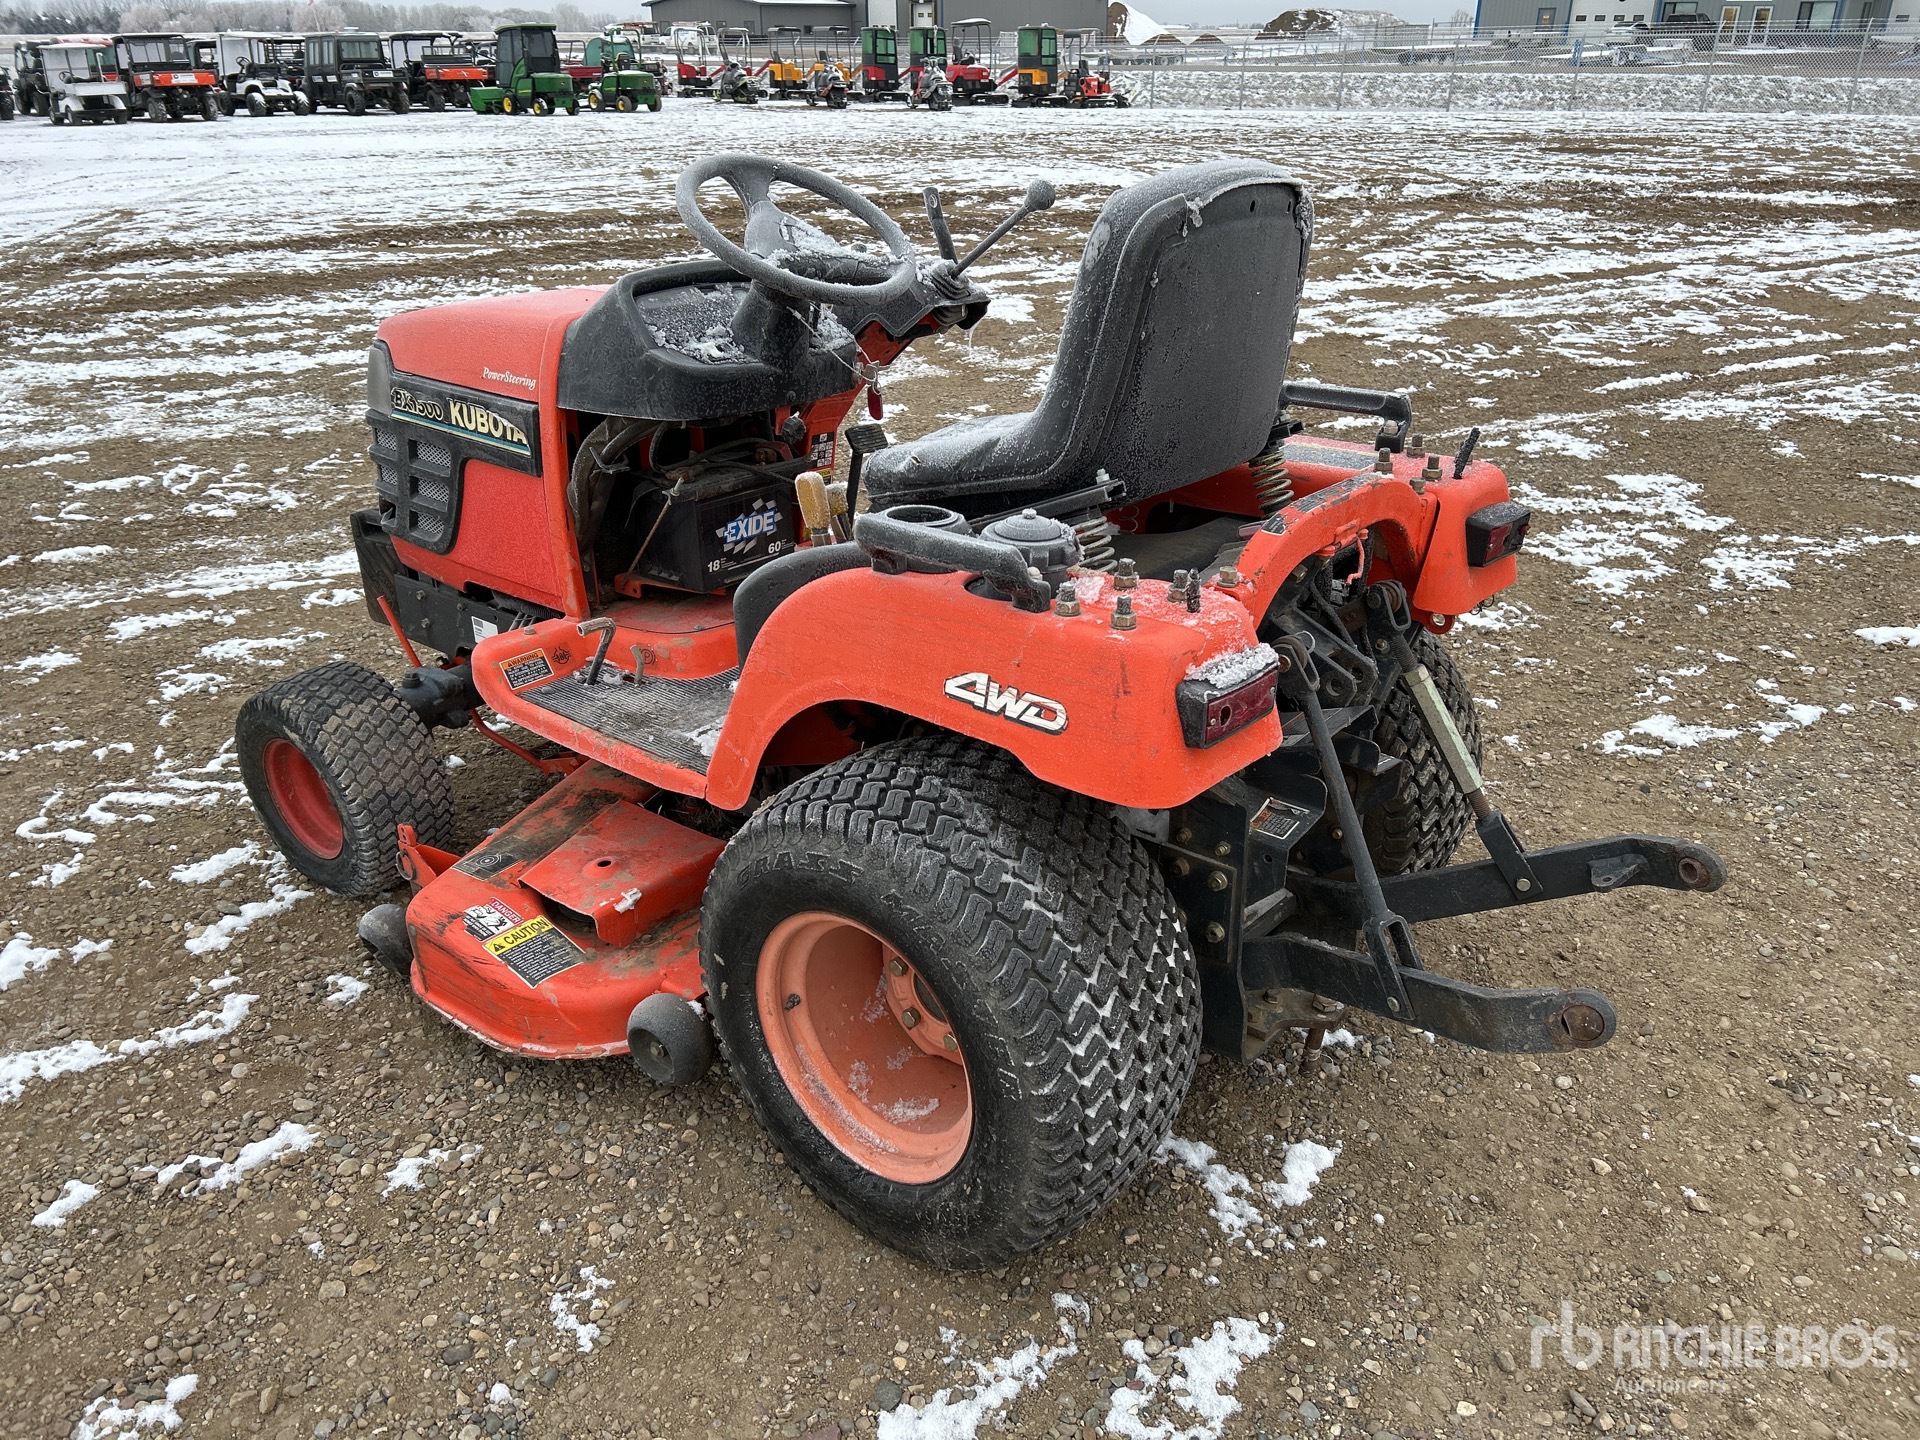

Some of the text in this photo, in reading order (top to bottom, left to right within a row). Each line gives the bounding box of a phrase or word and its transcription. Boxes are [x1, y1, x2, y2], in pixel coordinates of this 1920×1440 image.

[482, 367, 537, 391] PowerSteering
[449, 399, 528, 445] KUBOTA
[724, 511, 776, 544] EXIDE
[768, 540, 782, 554] 60
[707, 560, 720, 573] 18
[511, 653, 539, 666] WARNING
[943, 671, 1070, 736] 4WD
[737, 850, 865, 890] GRASS
[491, 901, 522, 924] DANGER
[503, 918, 550, 945] CAUTION
